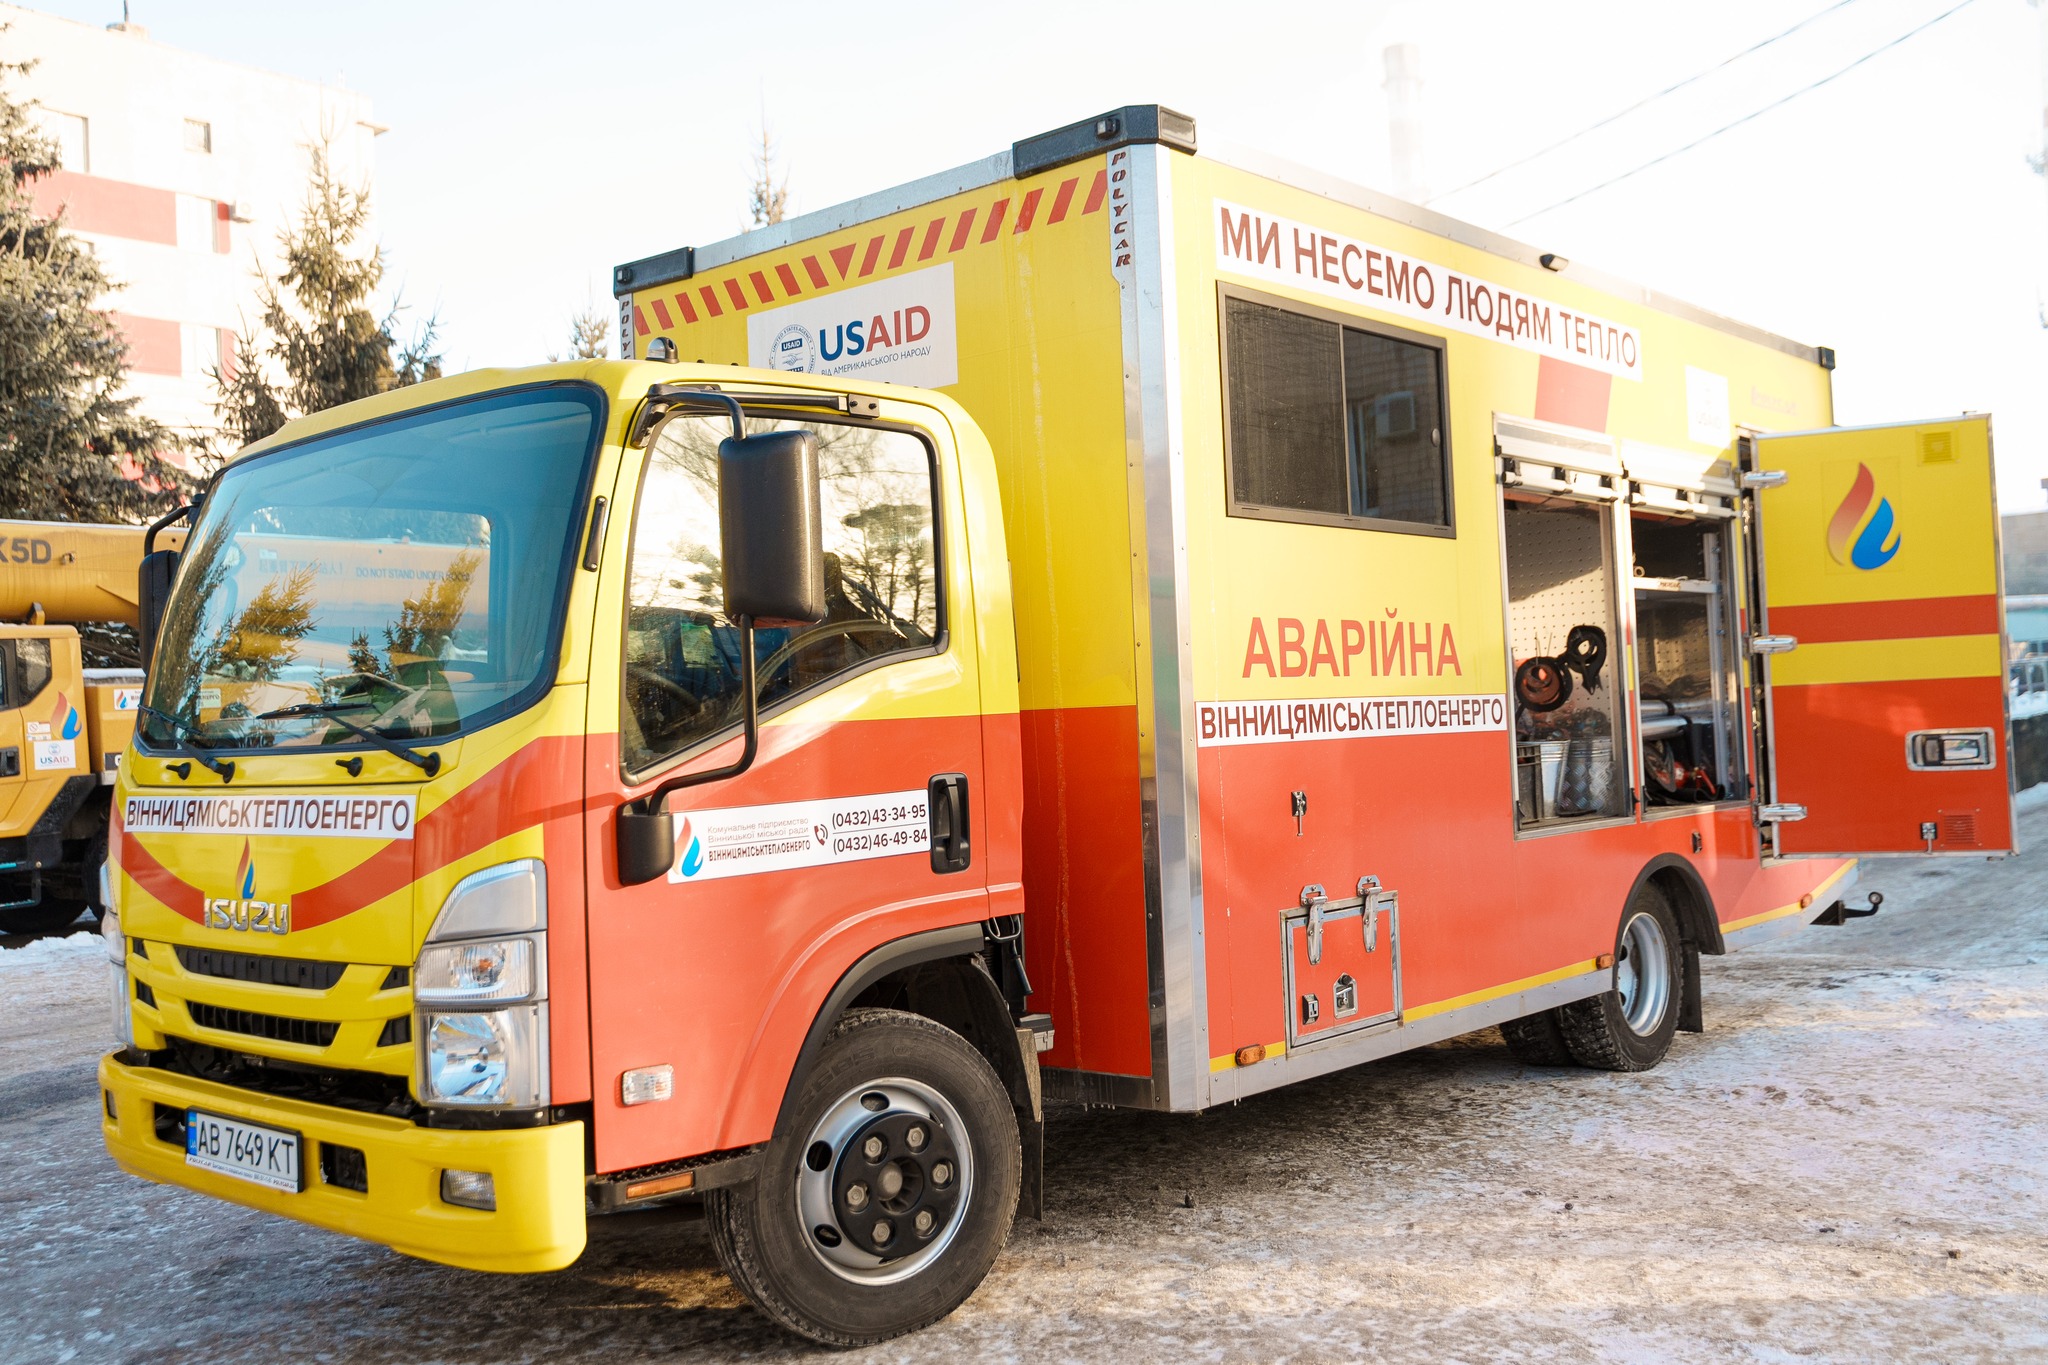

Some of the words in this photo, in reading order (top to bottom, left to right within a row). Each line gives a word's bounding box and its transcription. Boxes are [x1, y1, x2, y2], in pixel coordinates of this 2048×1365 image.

[1111, 151, 1131, 267] POLYCAR
[1220, 206, 1281, 269] МИ
[1293, 227, 1435, 310] НЕСЕМО
[1445, 275, 1552, 344] ЛЮДЯМ
[1559, 311, 1637, 368] ТЕПЛО
[783, 340, 801, 350] USAID
[819, 305, 931, 362] USAID
[833, 353, 899, 375] АМЕРИКАНСЬКОГО
[900, 345, 932, 361] НАРОДУ
[356, 567, 369, 578] DO
[370, 567, 386, 578] NOT
[388, 568, 415, 579] STAND
[1242, 607, 1462, 678] АВАРІЙНА
[1201, 698, 1503, 740] ВІННИЦЯМІСЬКТЕПЛОЕНЕРГО
[40, 756, 70, 764] USAID
[127, 799, 411, 832] ВІННИЦЯМІСЬКТЕПЛОЕНЕРГО
[707, 823, 757, 834] Комунальне
[758, 817, 809, 829] підприємство
[831, 804, 926, 829] (0432)43-34-95
[708, 832, 755, 843] Вінницької
[757, 827, 787, 838] міської
[788, 826, 809, 836] ради
[832, 828, 928, 855] (0432)46-49-84
[708, 840, 811, 862] ВІННИЦЯМІСЬКТЕПЛОЕНЕРГО
[203, 897, 290, 936] ISUZU
[198, 1120, 221, 1156] AB
[225, 1126, 264, 1167] 7649
[268, 1136, 295, 1175] KT
